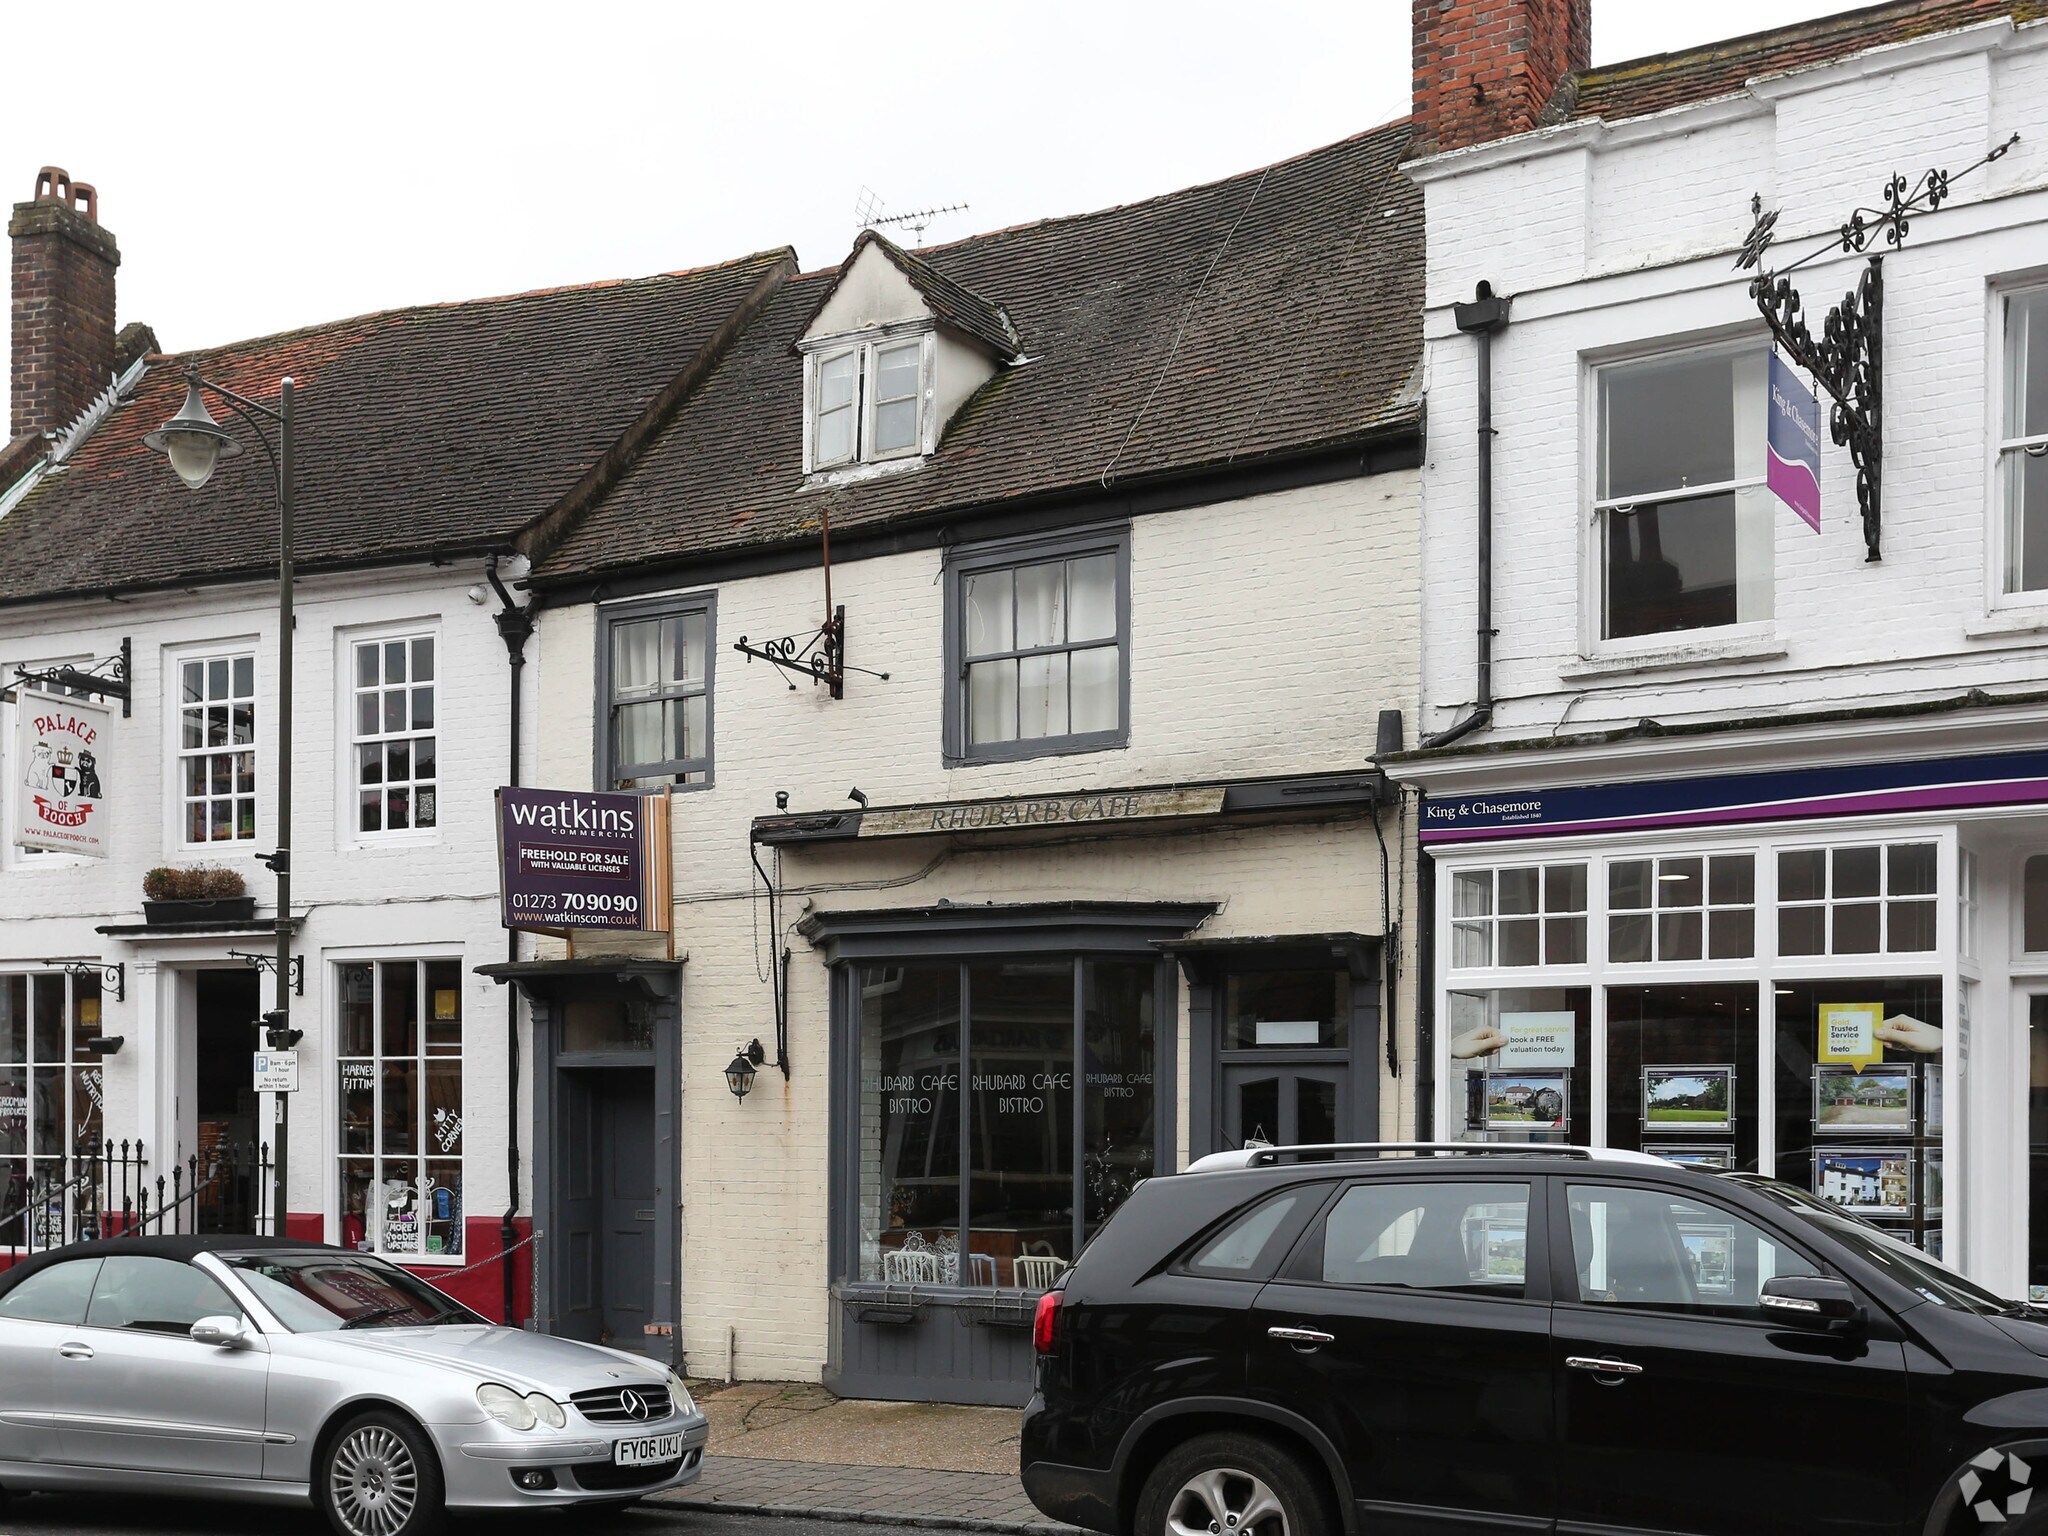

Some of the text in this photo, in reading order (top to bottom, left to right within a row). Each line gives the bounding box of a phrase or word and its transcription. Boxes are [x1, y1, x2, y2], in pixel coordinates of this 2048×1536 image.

[1772, 384, 1786, 417] King
[33, 714, 97, 745] PALACE
[57, 801, 68, 811] OF
[929, 796, 1143, 830] RHUBARB CAFE
[1426, 801, 1542, 820] King & Chasemore
[42, 808, 83, 825] POOCH
[510, 799, 634, 832] watkins
[24, 828, 99, 844] WWW.PALACEOFPOOCH.COM
[551, 829, 634, 839] COMMERCIAL
[521, 848, 629, 866] FREEHOLD FOR SALE
[531, 861, 621, 873] WITH VALUABLE LICENSES
[512, 893, 557, 909] 01273
[513, 910, 638, 925] www.watkinscom.co.uk
[1523, 1026, 1543, 1034] great
[258, 1057, 267, 1071] P
[342, 1065, 375, 1076] HARNES
[90, 1069, 103, 1091] REA
[343, 1078, 375, 1092] FITTIN
[863, 1074, 958, 1091] RHUBARB CAFE
[972, 1073, 1072, 1090] RHUBARB CAFE
[1086, 1073, 1153, 1084] RHUBARB CAFE
[80, 1070, 103, 1113] NUTRITIO
[1104, 1087, 1134, 1097] BISTRO
[0, 1096, 28, 1108] ROOMIN
[889, 1097, 932, 1114] BISTRO
[999, 1096, 1044, 1113] BISTRO
[434, 1109, 458, 1142] KITTY
[389, 1222, 413, 1233] MORE
[386, 1231, 418, 1242] GOODIES
[387, 1241, 418, 1250] UPSTAIRS
[620, 1437, 678, 1461] FY06 UXJ
